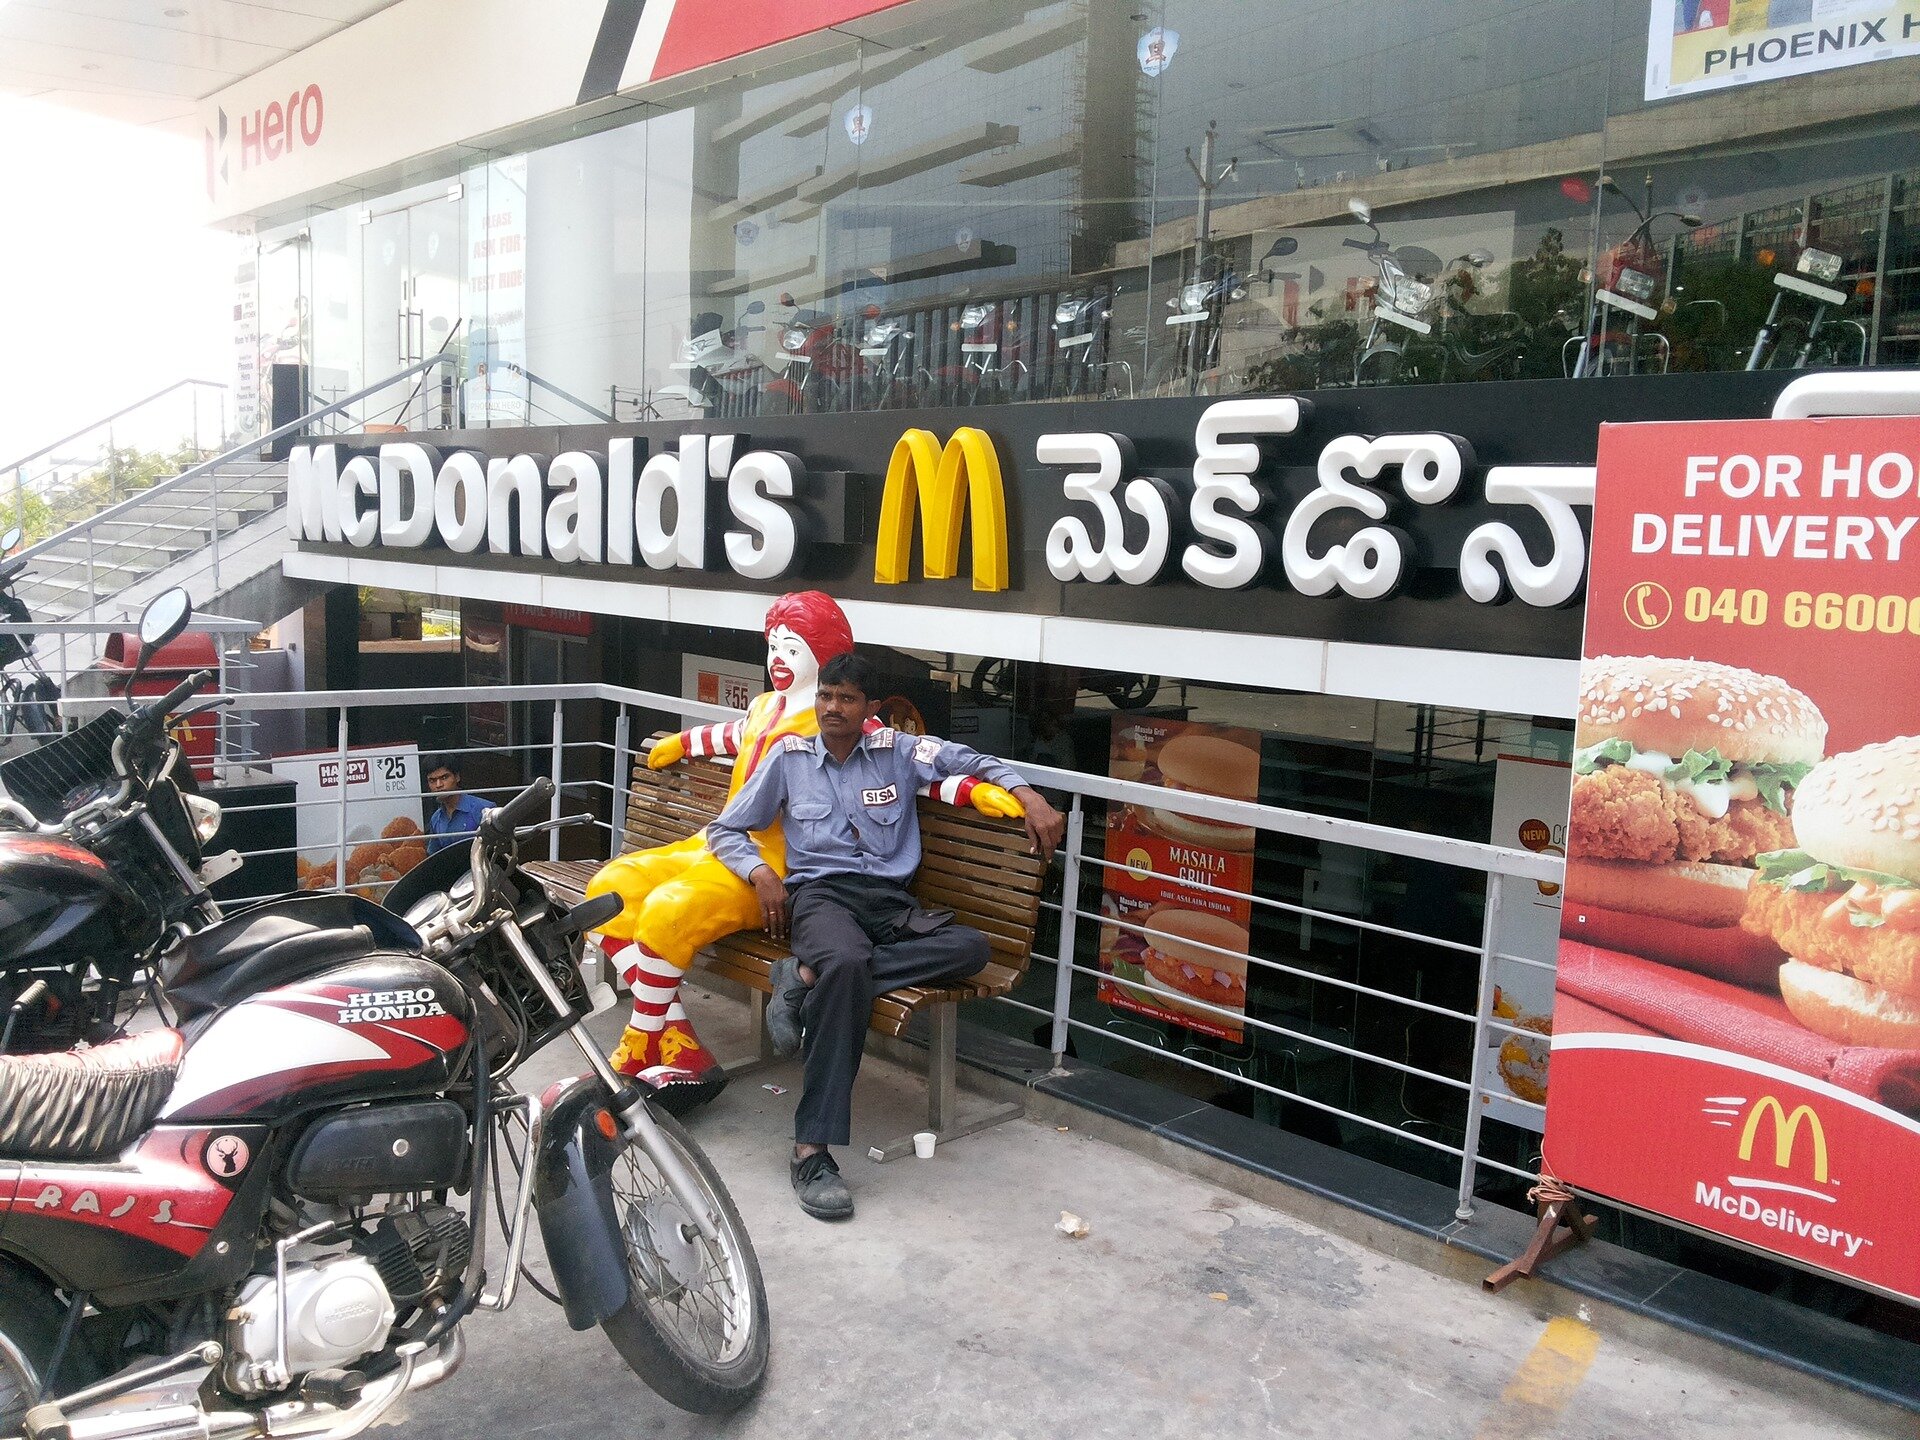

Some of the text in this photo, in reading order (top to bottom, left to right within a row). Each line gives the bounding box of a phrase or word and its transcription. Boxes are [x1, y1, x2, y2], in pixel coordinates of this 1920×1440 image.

[1704, 16, 1888, 75] PHOENIX
[241, 83, 324, 171] Hero
[1684, 452, 1920, 499] FOR HO
[286, 434, 796, 579] McDonald's
[1631, 513, 1920, 561] DELIVERY
[1684, 586, 1768, 626] 040
[321, 762, 366, 778] HAPY
[866, 788, 895, 803] SISA
[1522, 829, 1547, 841] NEW
[1129, 857, 1149, 873] NEW
[1169, 845, 1226, 873] MASALA
[347, 988, 436, 1008] HERO
[337, 1002, 447, 1024] HONDA
